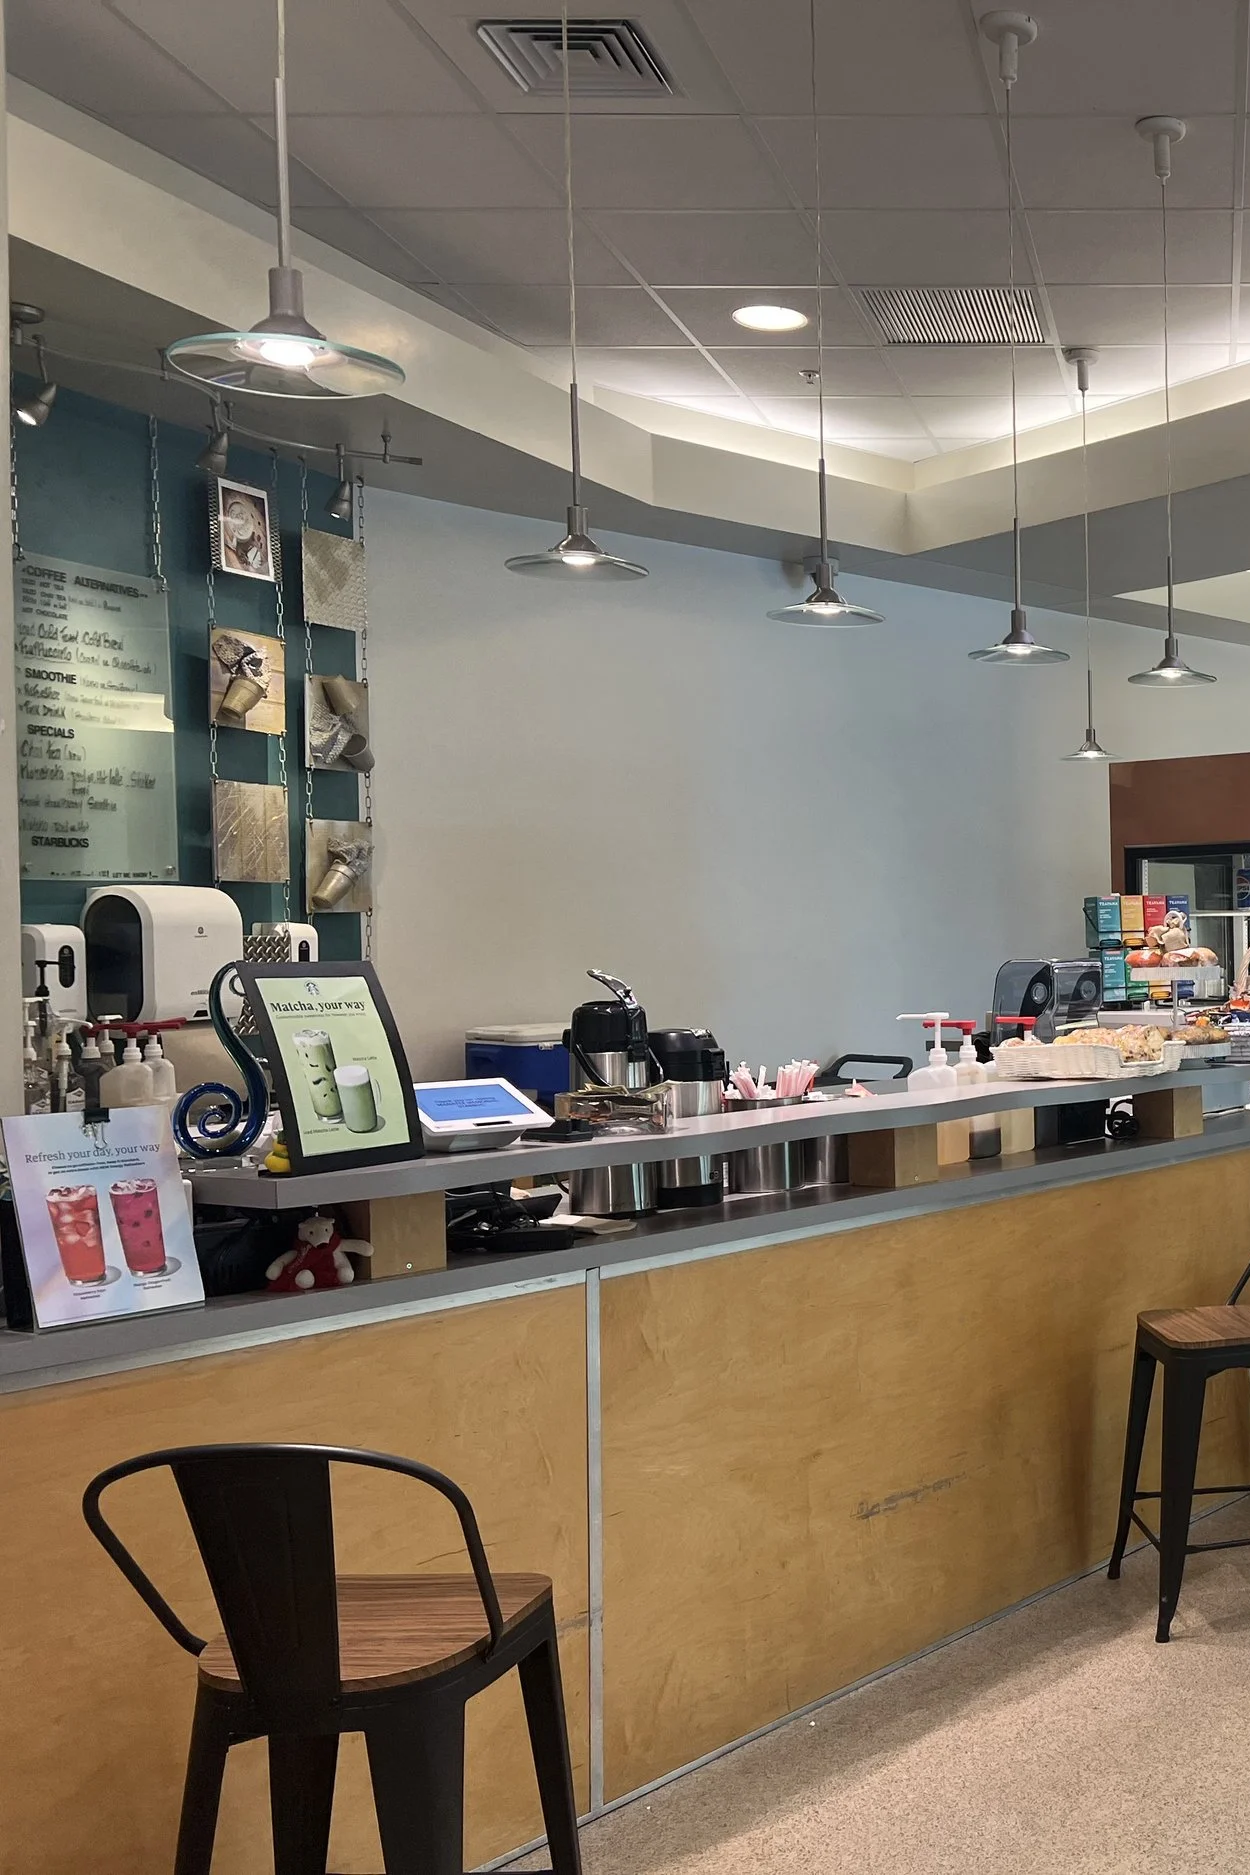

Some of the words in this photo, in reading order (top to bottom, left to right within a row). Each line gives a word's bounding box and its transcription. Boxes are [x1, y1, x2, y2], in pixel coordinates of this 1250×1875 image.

[26, 565, 67, 583] COFFEE
[24, 667, 77, 685] SMOOTHIE
[27, 724, 75, 739] SPECIALS
[31, 835, 90, 848] STARBUCKS
[270, 1001, 318, 1013] Matcha,
[318, 1001, 343, 1012] your
[345, 1001, 366, 1011] way
[25, 1151, 65, 1163] Refresh
[67, 1150, 92, 1161] your
[116, 1145, 138, 1157] your
[140, 1143, 161, 1153] way
